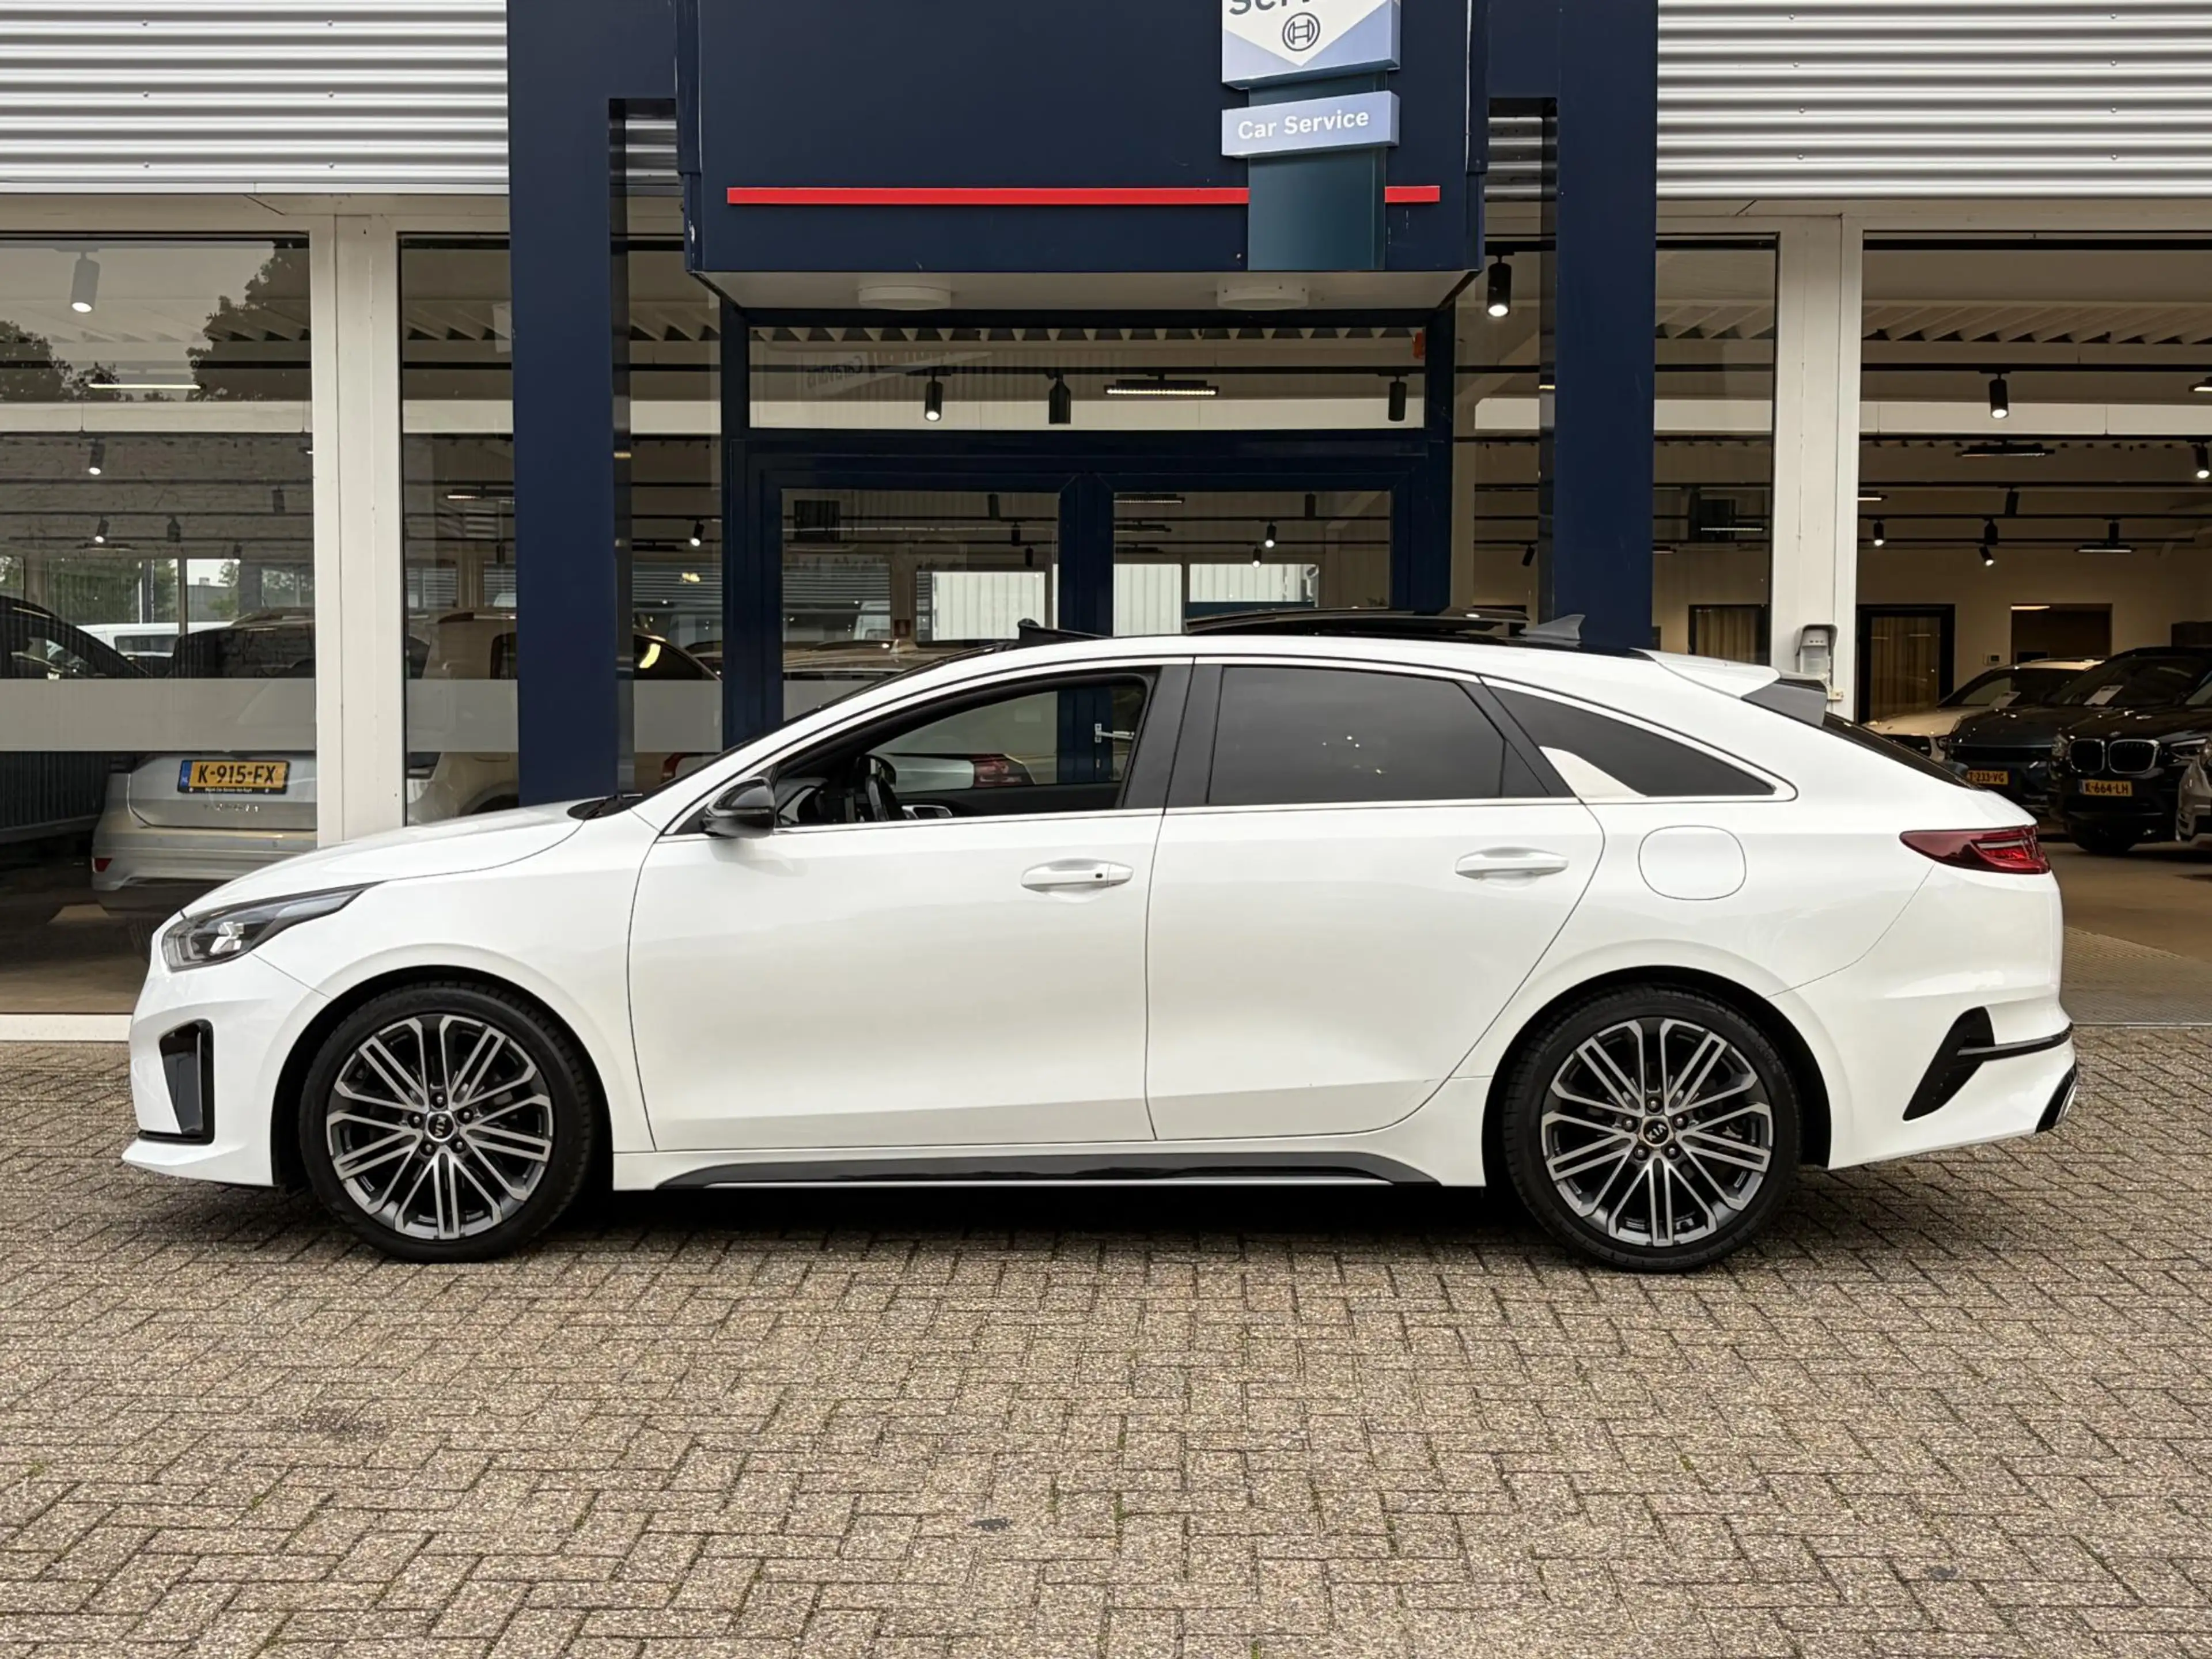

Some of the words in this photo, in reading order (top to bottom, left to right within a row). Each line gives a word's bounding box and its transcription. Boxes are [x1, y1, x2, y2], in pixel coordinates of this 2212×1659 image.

[1238, 120, 1277, 139] Car
[1283, 109, 1369, 135] Service
[197, 764, 276, 784] K-915-FX
[1646, 1123, 1667, 1141] KIA
